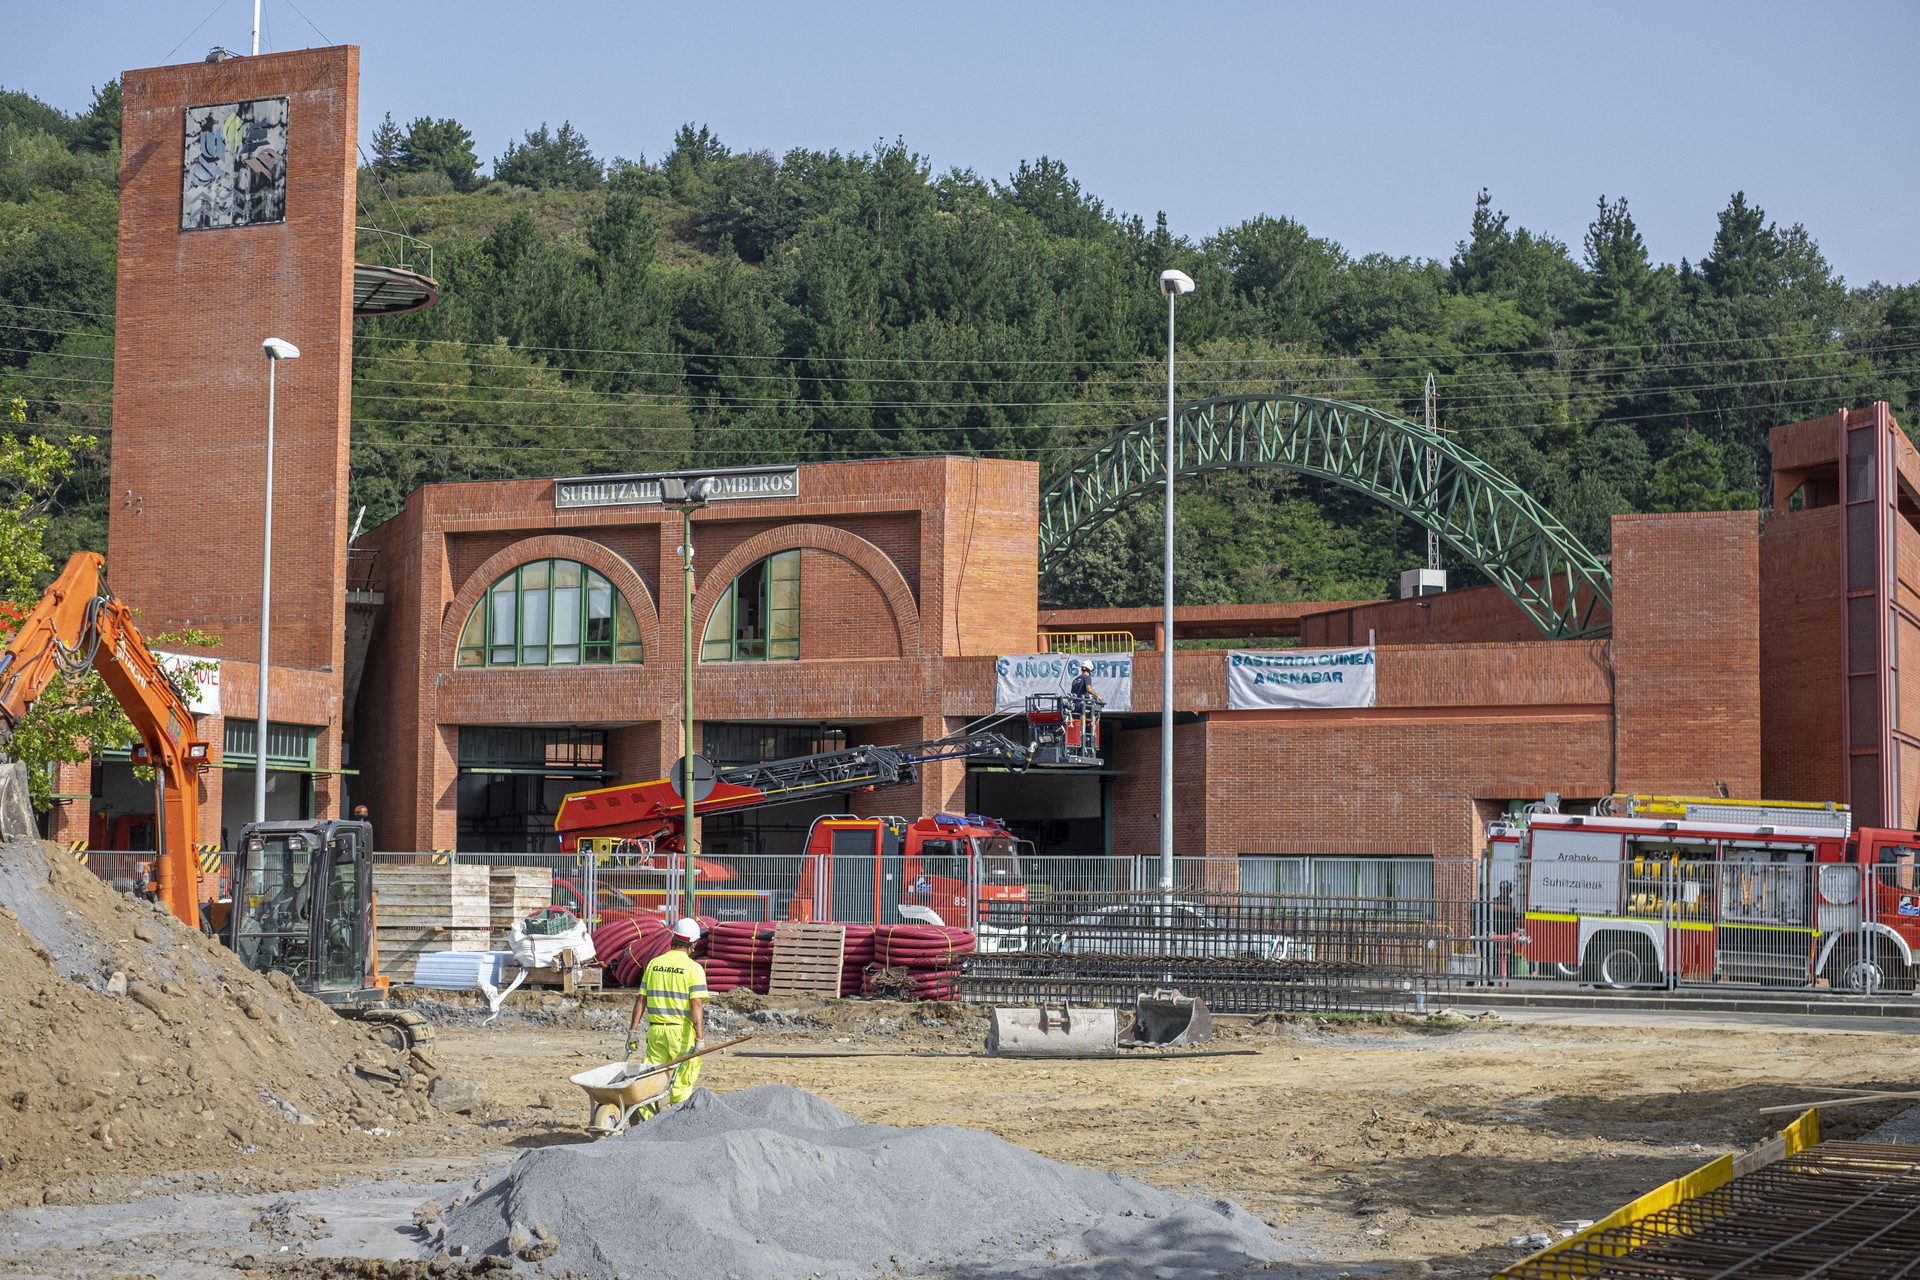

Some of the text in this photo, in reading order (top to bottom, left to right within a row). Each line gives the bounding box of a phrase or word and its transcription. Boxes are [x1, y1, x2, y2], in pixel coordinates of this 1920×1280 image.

[561, 475, 793, 501] SUHILTZAIL OMBEROS
[1232, 653, 1374, 667] BASTERRA GUINEA
[1015, 656, 1062, 679] AÑOS
[1068, 659, 1080, 677] 6
[1254, 672, 1343, 685] AMENABAR
[1558, 852, 1599, 862] Arabako
